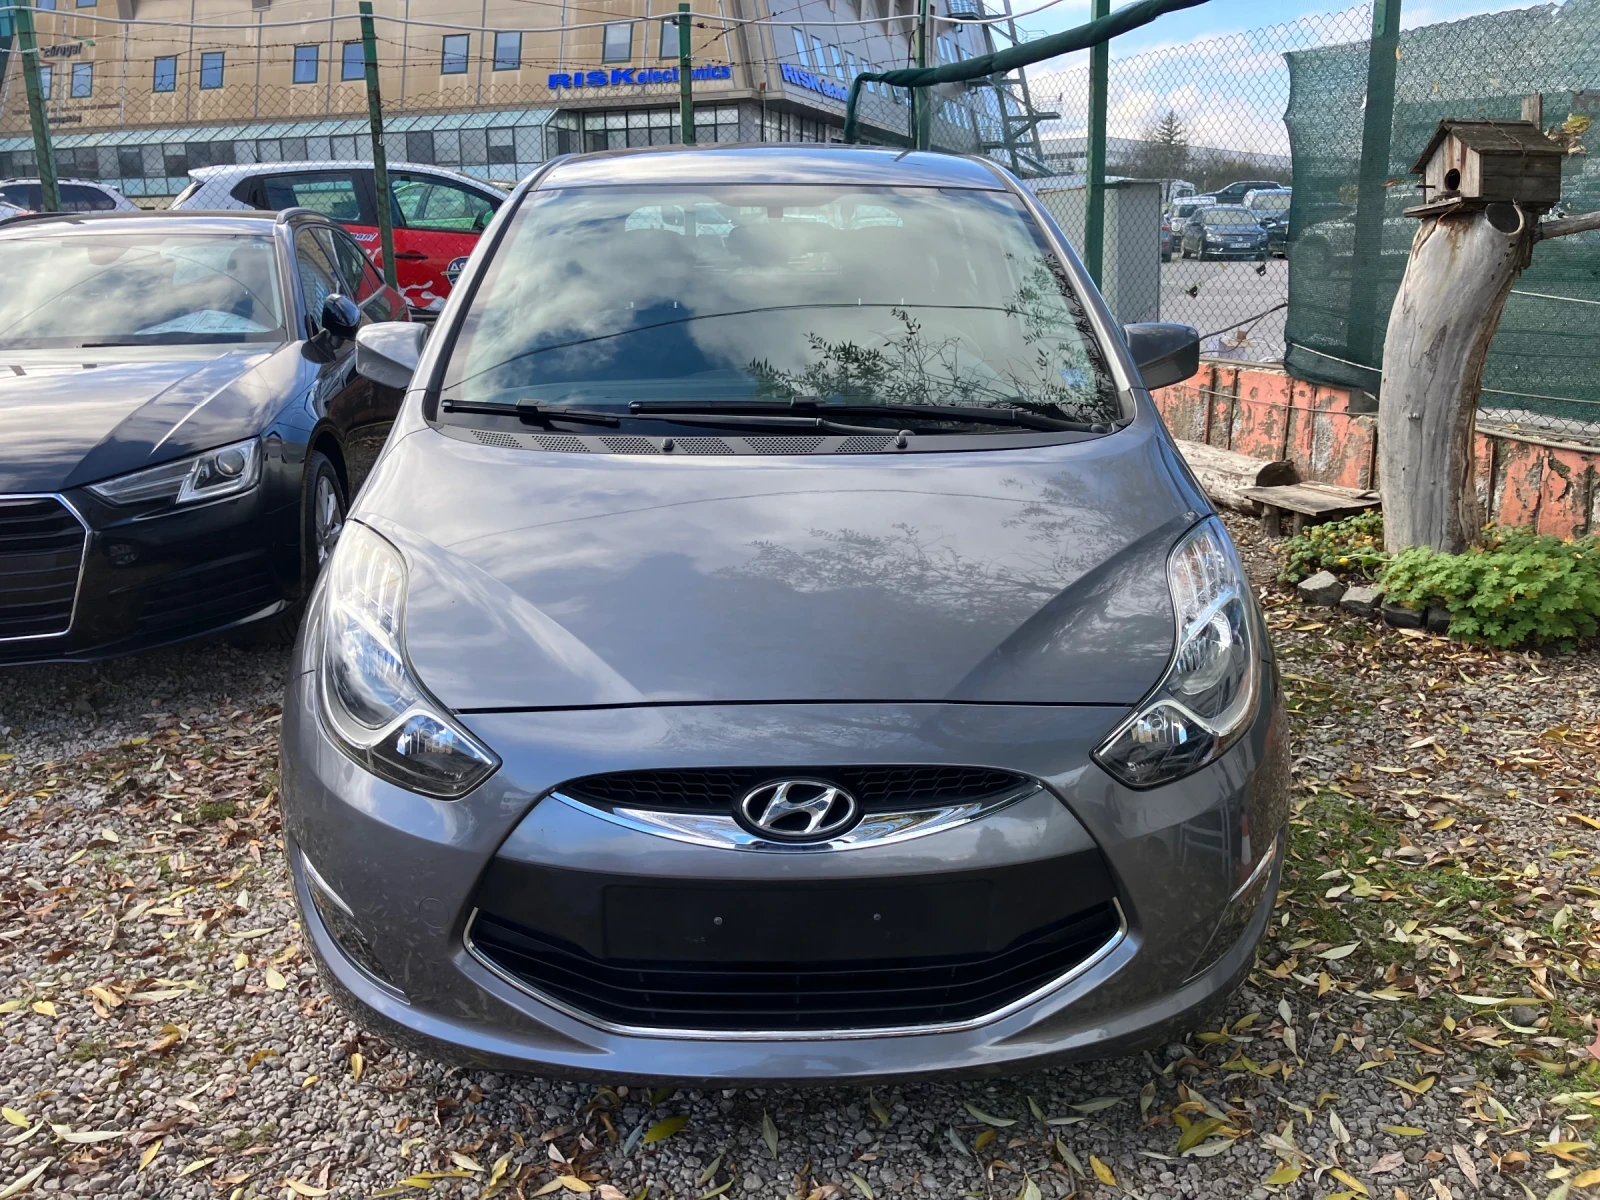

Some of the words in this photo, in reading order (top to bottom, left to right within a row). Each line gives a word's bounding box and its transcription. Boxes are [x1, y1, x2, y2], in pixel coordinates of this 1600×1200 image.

[548, 69, 636, 89] RISK
[637, 64, 731, 84] electnics
[780, 63, 822, 93] RISK
